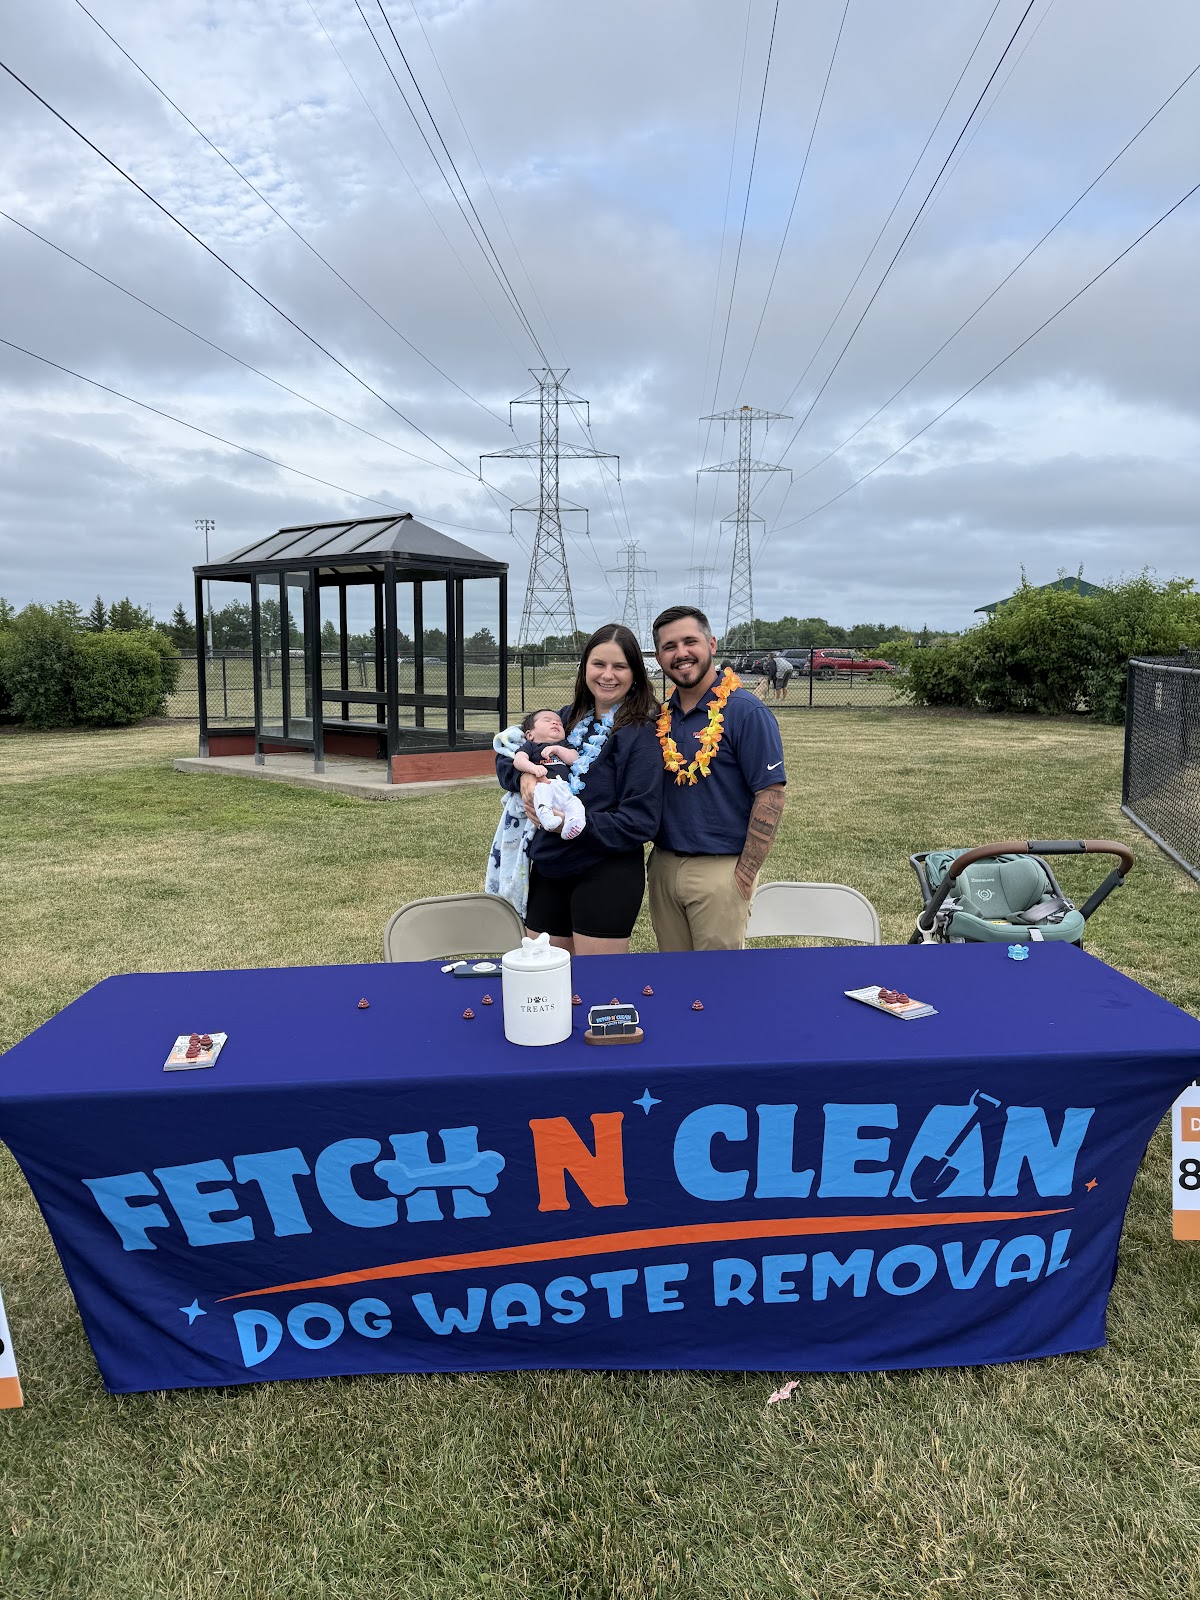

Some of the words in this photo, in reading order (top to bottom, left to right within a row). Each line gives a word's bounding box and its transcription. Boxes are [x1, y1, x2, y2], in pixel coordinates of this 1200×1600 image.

[520, 1003, 555, 1013] TREATS
[82, 1126, 505, 1251] FETCH
[530, 1112, 628, 1211] N
[674, 1088, 1096, 1202] CLEAN
[233, 1298, 392, 1367] DOG
[412, 1263, 689, 1335] WASTE
[713, 1229, 1071, 1307] REMOVAL
